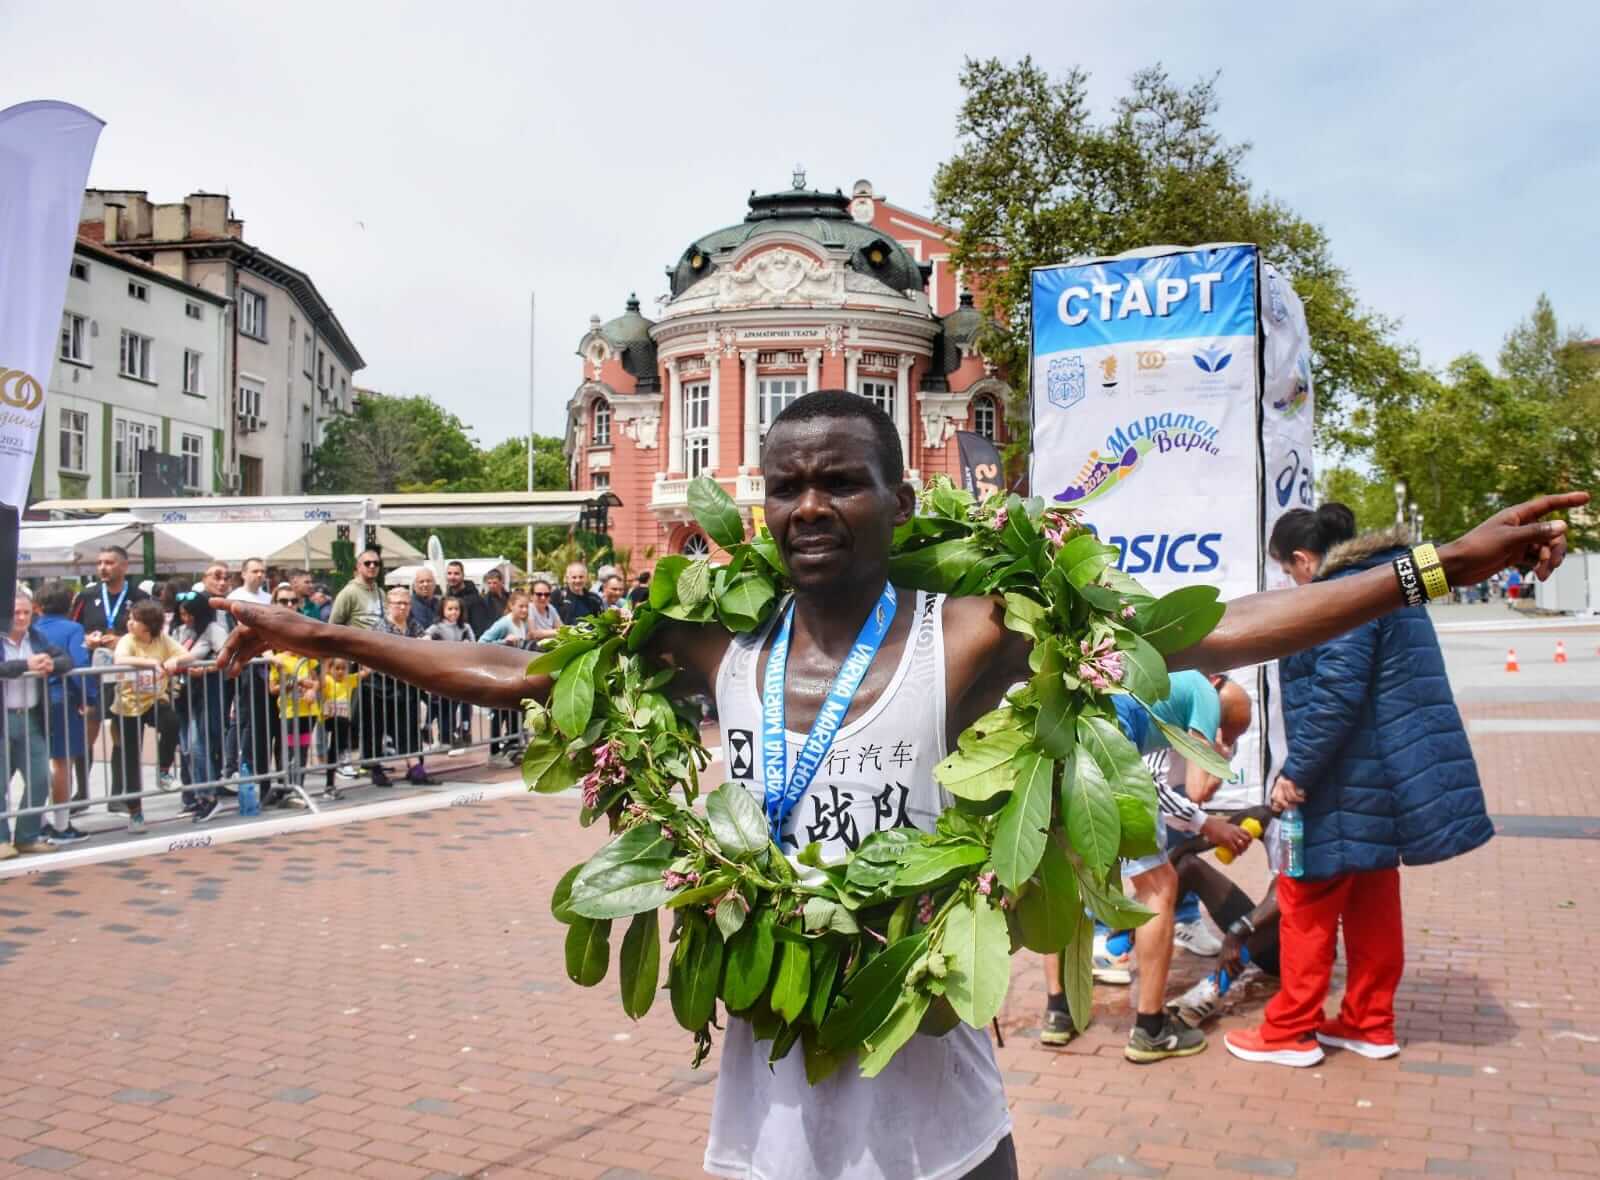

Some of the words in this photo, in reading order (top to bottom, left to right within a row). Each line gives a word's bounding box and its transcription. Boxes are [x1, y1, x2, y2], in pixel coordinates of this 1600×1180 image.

[1057, 272, 1223, 326] СТАРТ
[1106, 412, 1221, 459] Маратон
[1152, 429, 1221, 456] Варна
[765, 640, 787, 735] MARATHON
[834, 643, 874, 698] VARNA
[765, 741, 786, 803] VARNA
[787, 702, 845, 801] MARATHON
[795, 740, 913, 777] 行汽车
[780, 781, 921, 853] 战队
